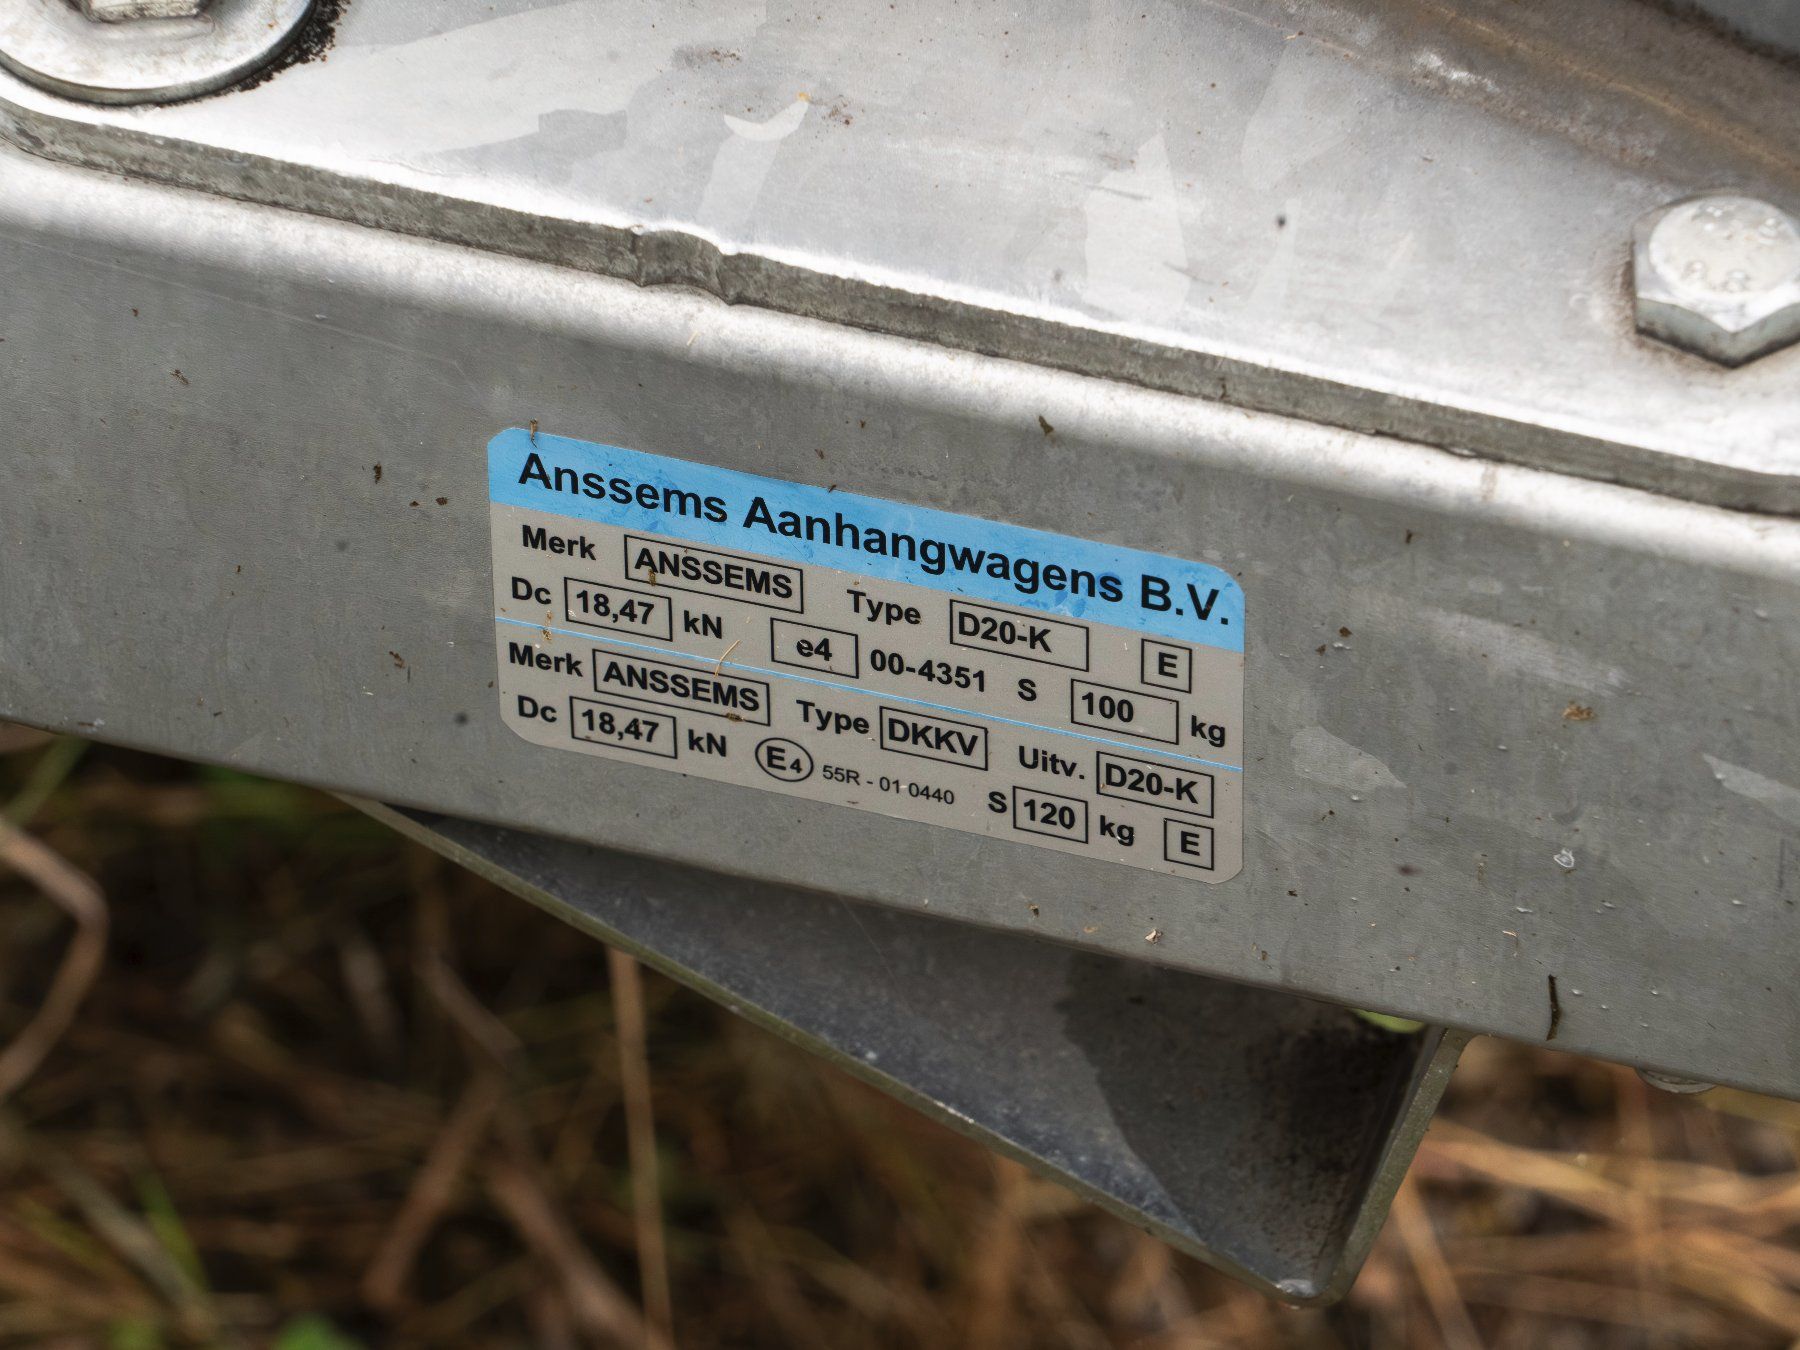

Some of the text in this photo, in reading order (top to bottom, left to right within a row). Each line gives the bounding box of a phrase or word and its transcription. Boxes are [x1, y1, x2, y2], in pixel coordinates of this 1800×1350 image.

[518, 452, 1229, 625] Anssems Aanhangwagens B.V.
[522, 525, 1178, 678] Merk ANSSEMS Type D20-K E
[509, 642, 1198, 804] Merk ANSSEMS Type DKKV Uitv. D20-K
[511, 576, 1225, 747] Dc 18,47 kN e4 00-4351 S 100 kg
[518, 695, 557, 723] Dc
[582, 709, 659, 743] 18,47
[688, 729, 727, 757] kN
[988, 791, 1008, 813] S
[1024, 799, 1075, 829] 120
[1100, 816, 1134, 846] kg
[1180, 831, 1200, 856] E
